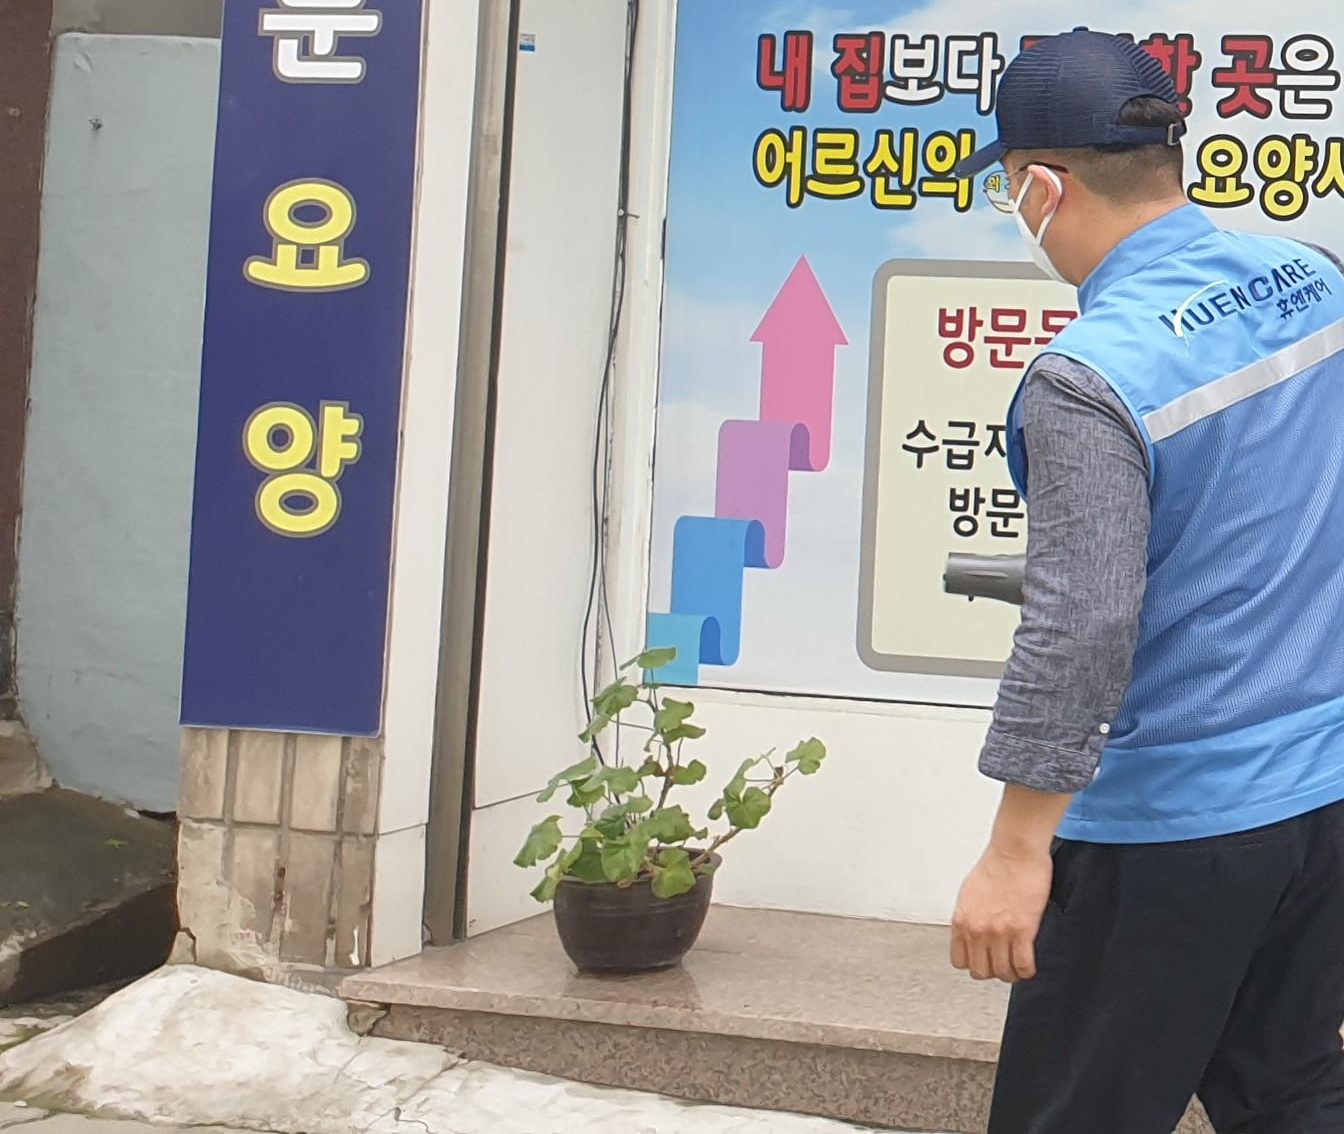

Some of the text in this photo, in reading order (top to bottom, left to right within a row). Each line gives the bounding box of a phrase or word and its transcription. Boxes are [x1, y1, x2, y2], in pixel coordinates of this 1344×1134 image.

[756, 29, 812, 114] 내
[830, 30, 1001, 116] 집보다
[1211, 33, 1341, 120] 곳은
[753, 125, 976, 211] 어르신의
